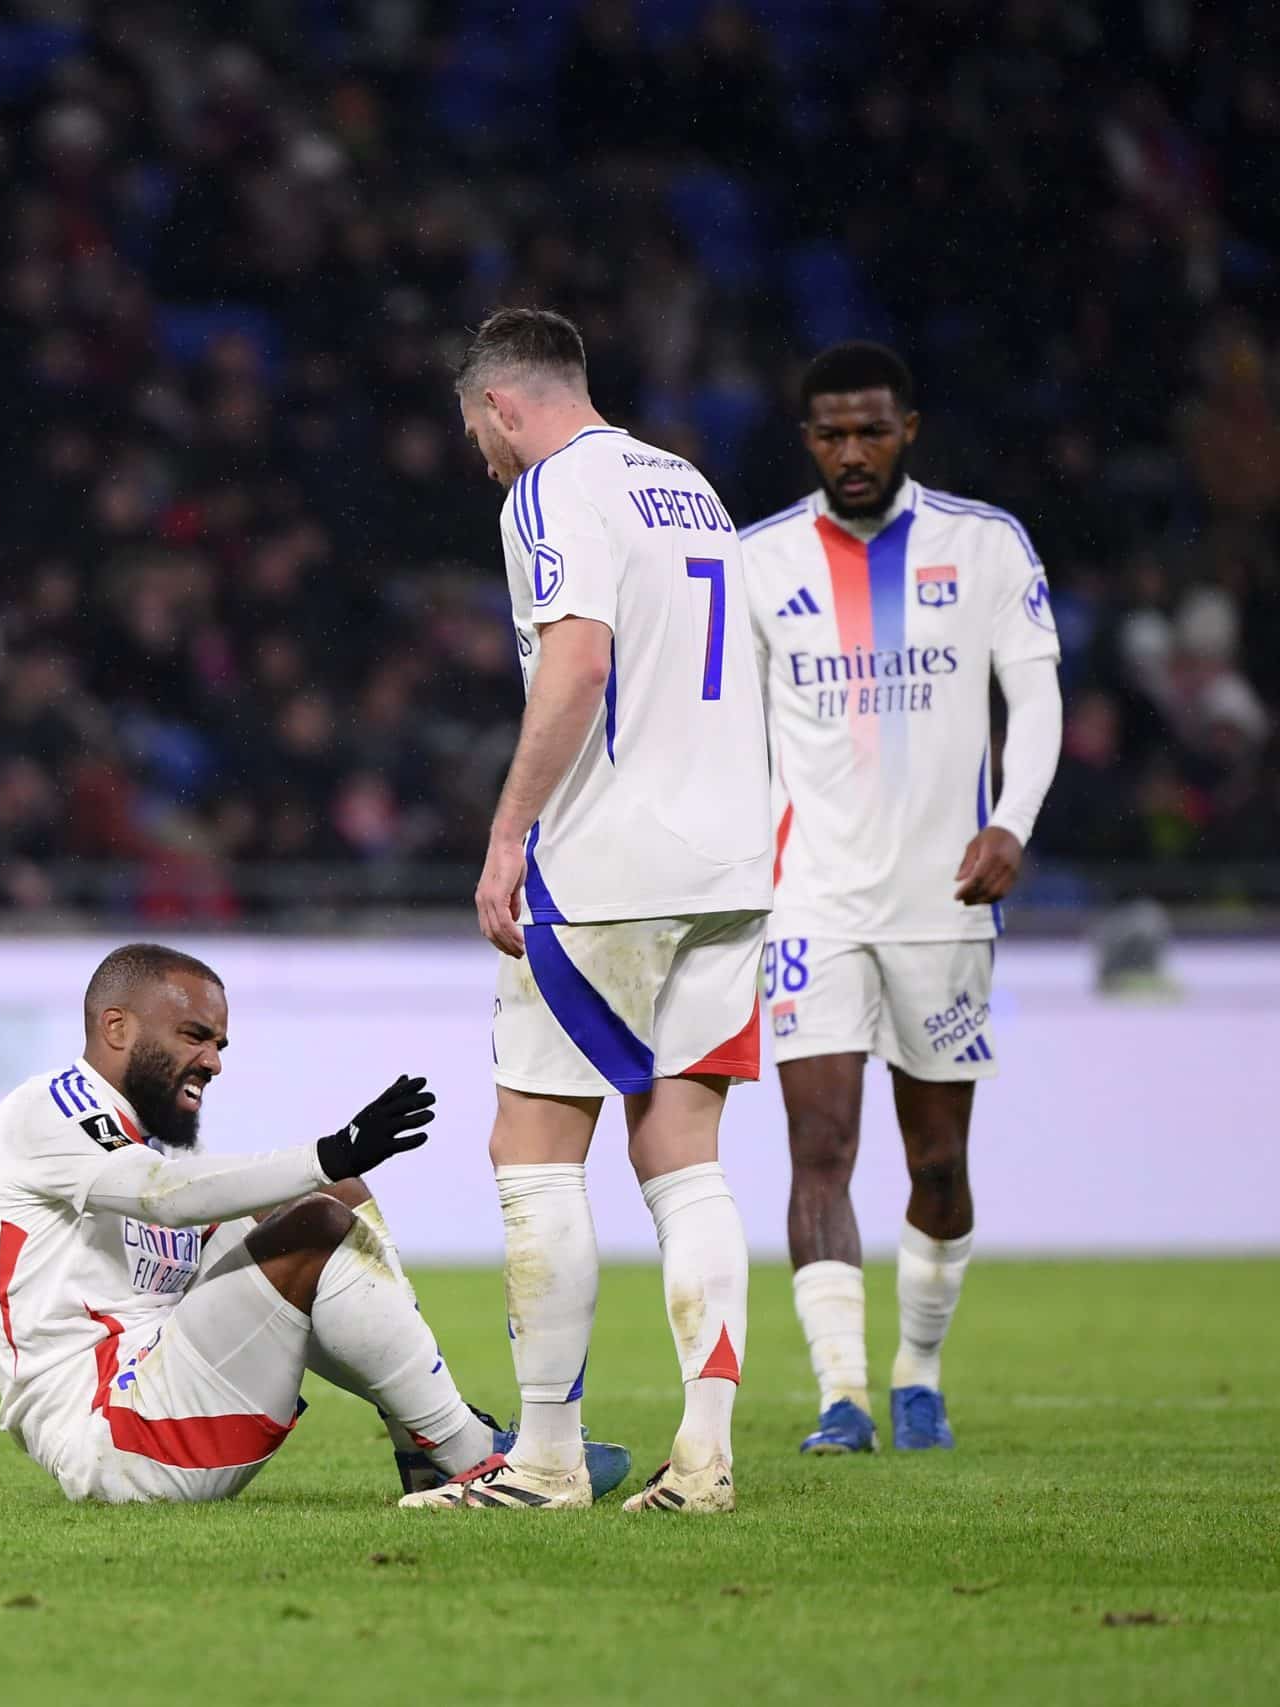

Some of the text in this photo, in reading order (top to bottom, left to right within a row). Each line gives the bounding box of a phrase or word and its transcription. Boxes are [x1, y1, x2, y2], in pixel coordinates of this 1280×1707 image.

[685, 556, 726, 701] 7
[790, 645, 958, 687] Emirates
[818, 683, 933, 718] FLY BETTER
[765, 938, 808, 998] 98
[923, 991, 972, 1035] Staff
[133, 1256, 161, 1290] FLY
